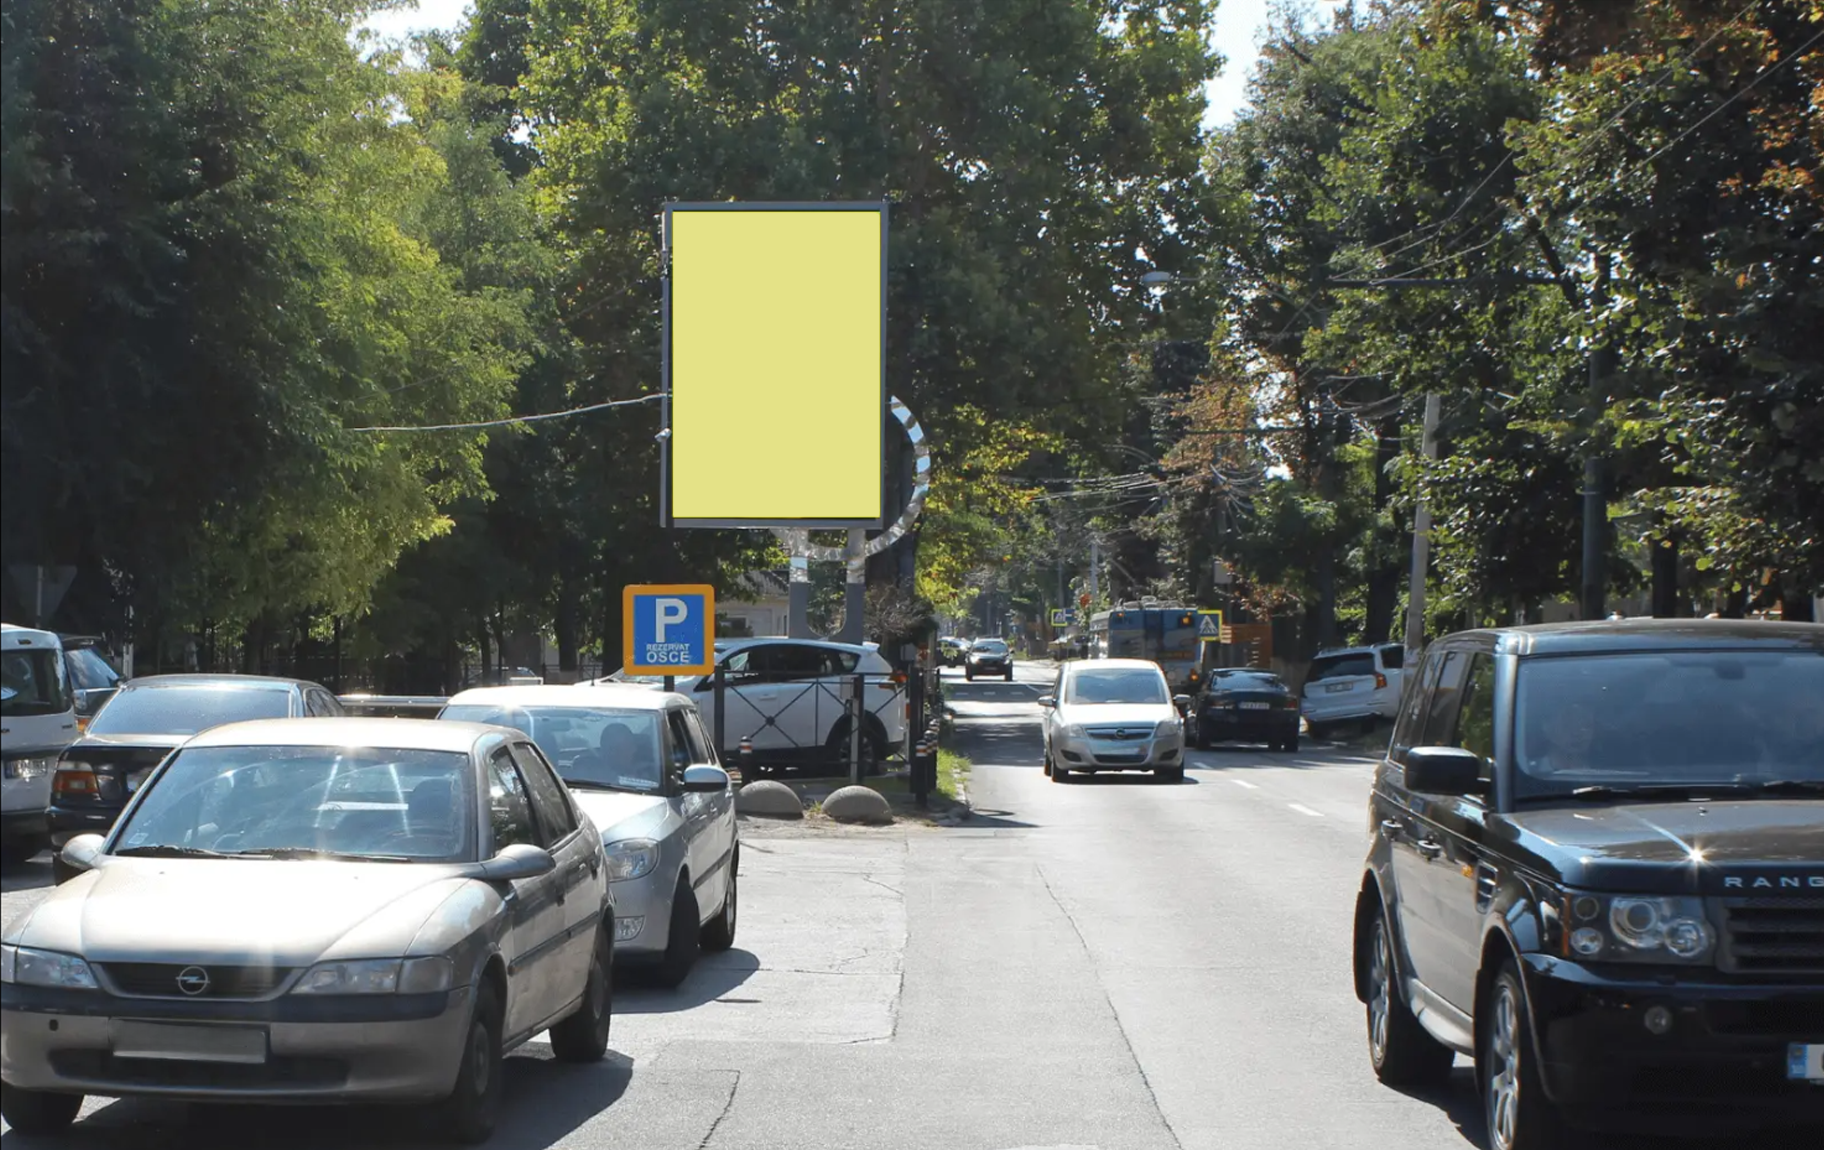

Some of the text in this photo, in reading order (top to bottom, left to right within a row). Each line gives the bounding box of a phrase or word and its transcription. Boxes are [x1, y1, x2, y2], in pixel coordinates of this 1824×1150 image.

[655, 598, 688, 643] P
[646, 643, 690, 651] REZERVAT
[646, 651, 690, 663] OSCE
